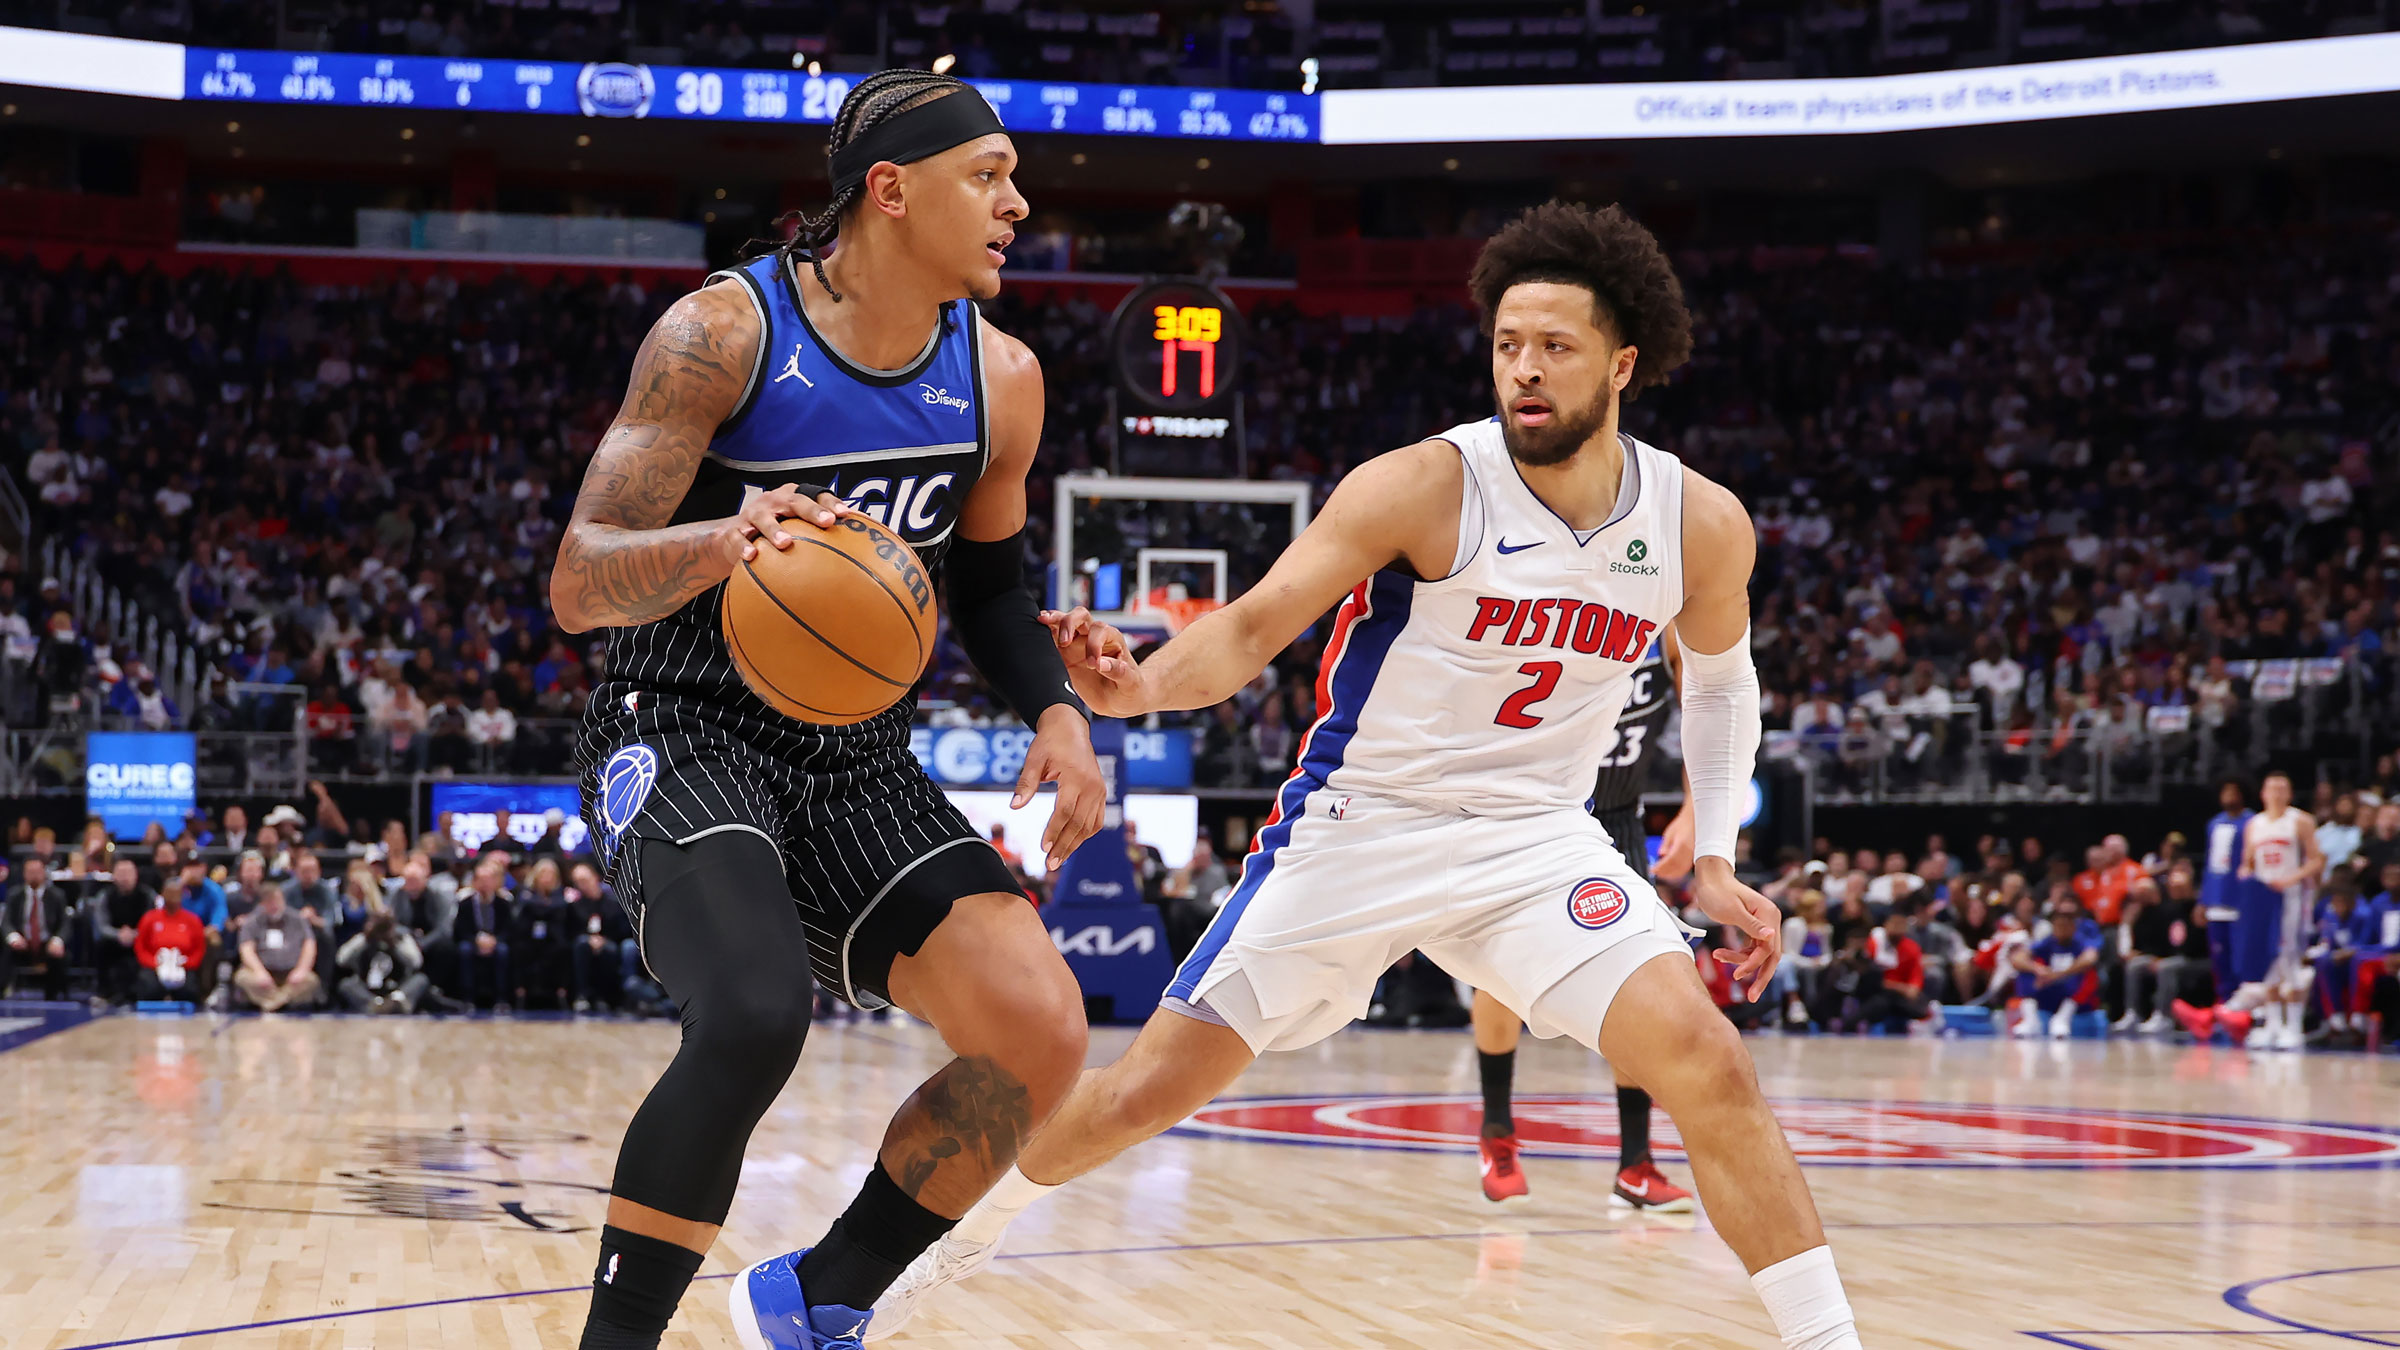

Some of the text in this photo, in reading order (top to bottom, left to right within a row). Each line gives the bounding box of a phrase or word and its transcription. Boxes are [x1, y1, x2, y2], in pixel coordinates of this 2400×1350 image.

[675, 72, 723, 115] 30
[802, 77, 849, 119] 20
[1635, 96, 1727, 121] Official
[1735, 99, 1798, 119] team
[1804, 93, 1934, 124] physicians
[1941, 84, 1967, 110] of
[1974, 85, 2013, 106] the
[2021, 77, 2112, 104] Detroit
[1161, 340, 1215, 398] 17
[738, 471, 956, 536] GIC
[1466, 596, 1657, 663] PISTONS
[1493, 661, 1563, 730] 2
[87, 763, 169, 788] CURE
[1577, 891, 1615, 908] DETROIT
[1580, 898, 1619, 917] PISTONS
[1050, 925, 1156, 956] KIA
